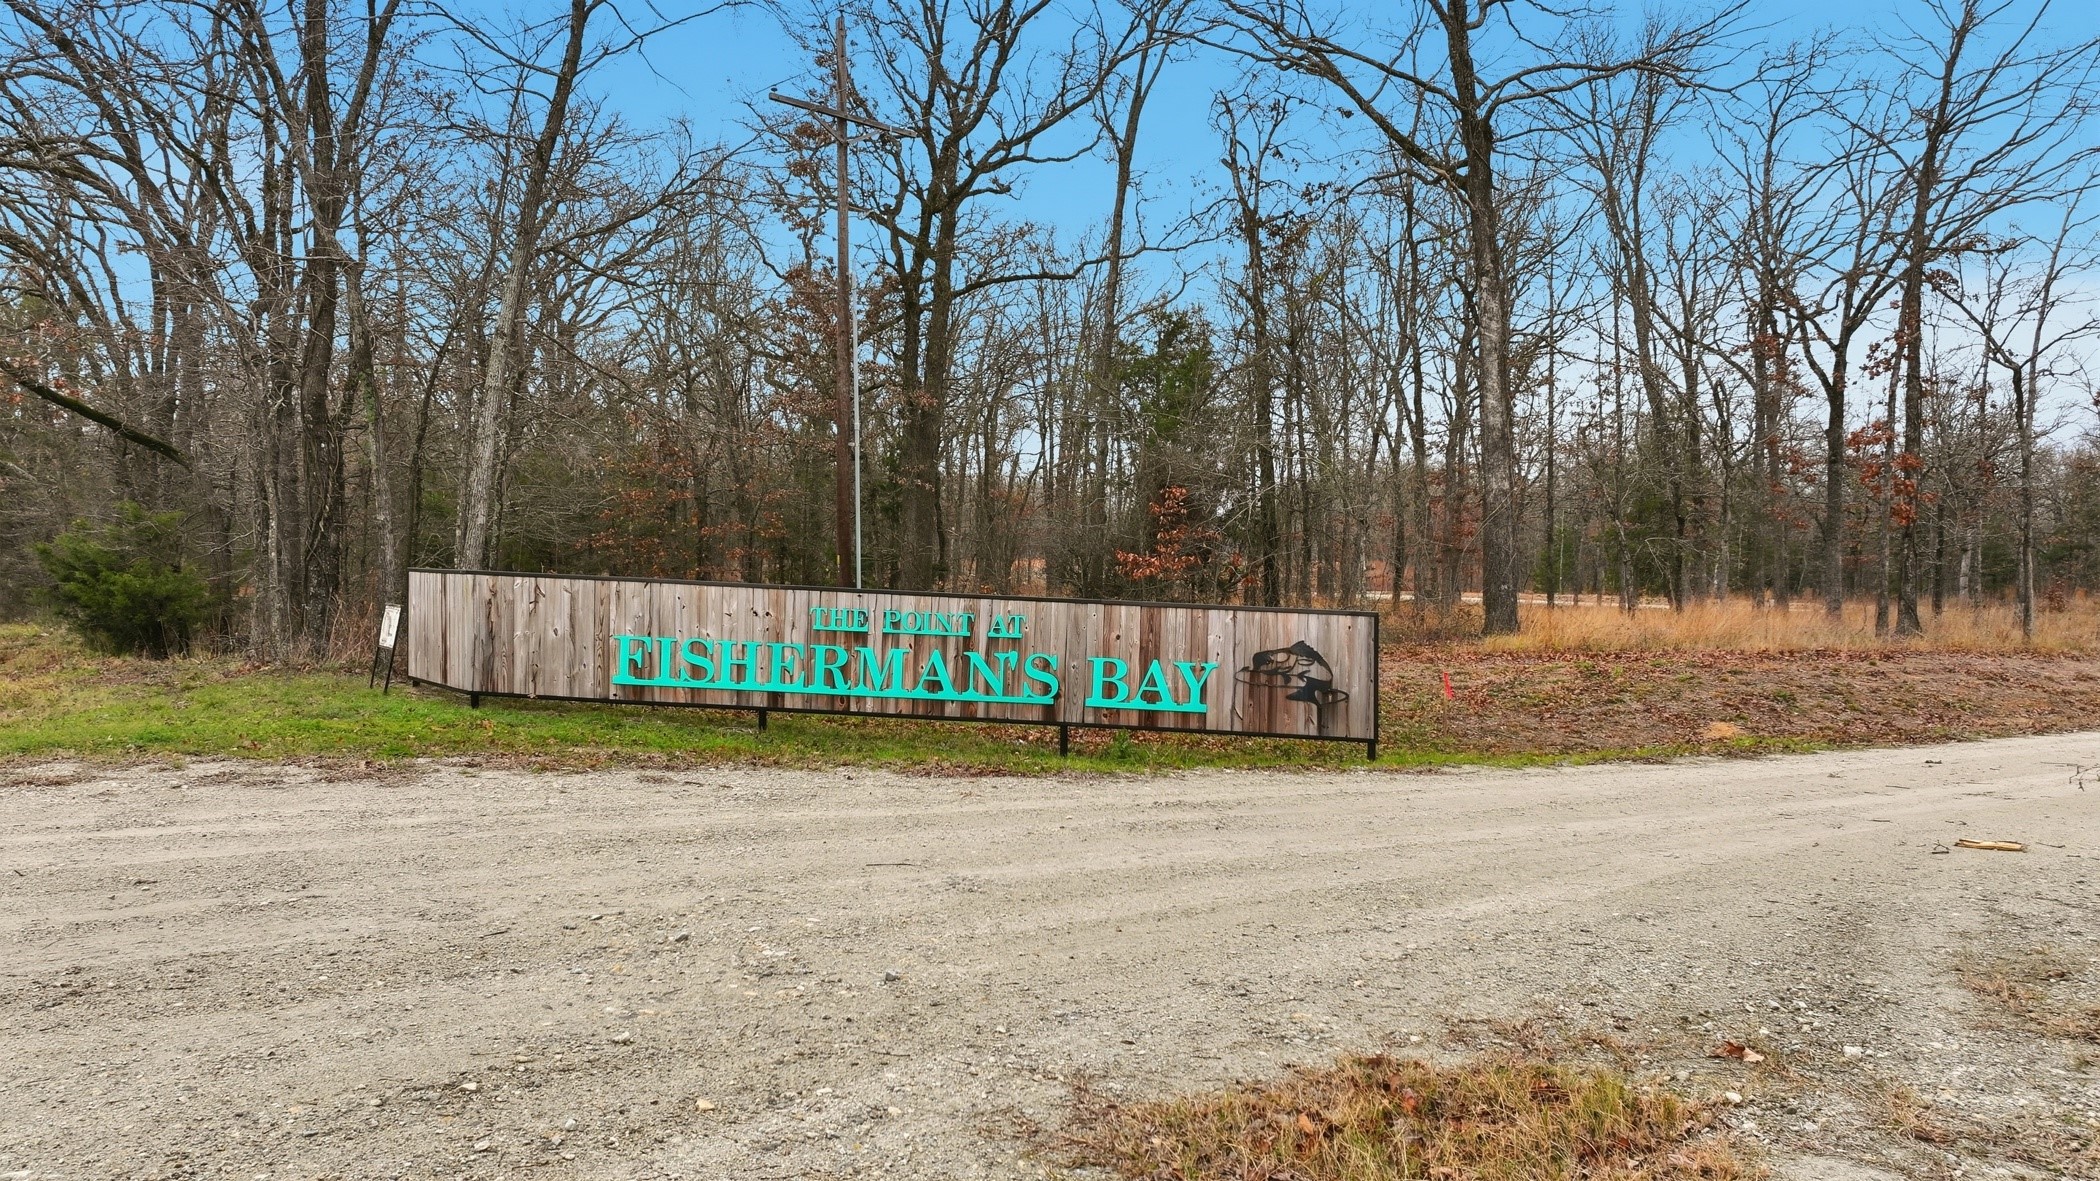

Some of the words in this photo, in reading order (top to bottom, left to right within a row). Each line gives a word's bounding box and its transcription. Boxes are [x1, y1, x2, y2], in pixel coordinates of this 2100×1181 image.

[810, 606, 869, 631] THE
[882, 610, 975, 636] POINT
[986, 614, 1026, 638] AT
[611, 634, 1060, 704] FISHERMAN'S
[1085, 656, 1219, 712] BAY
